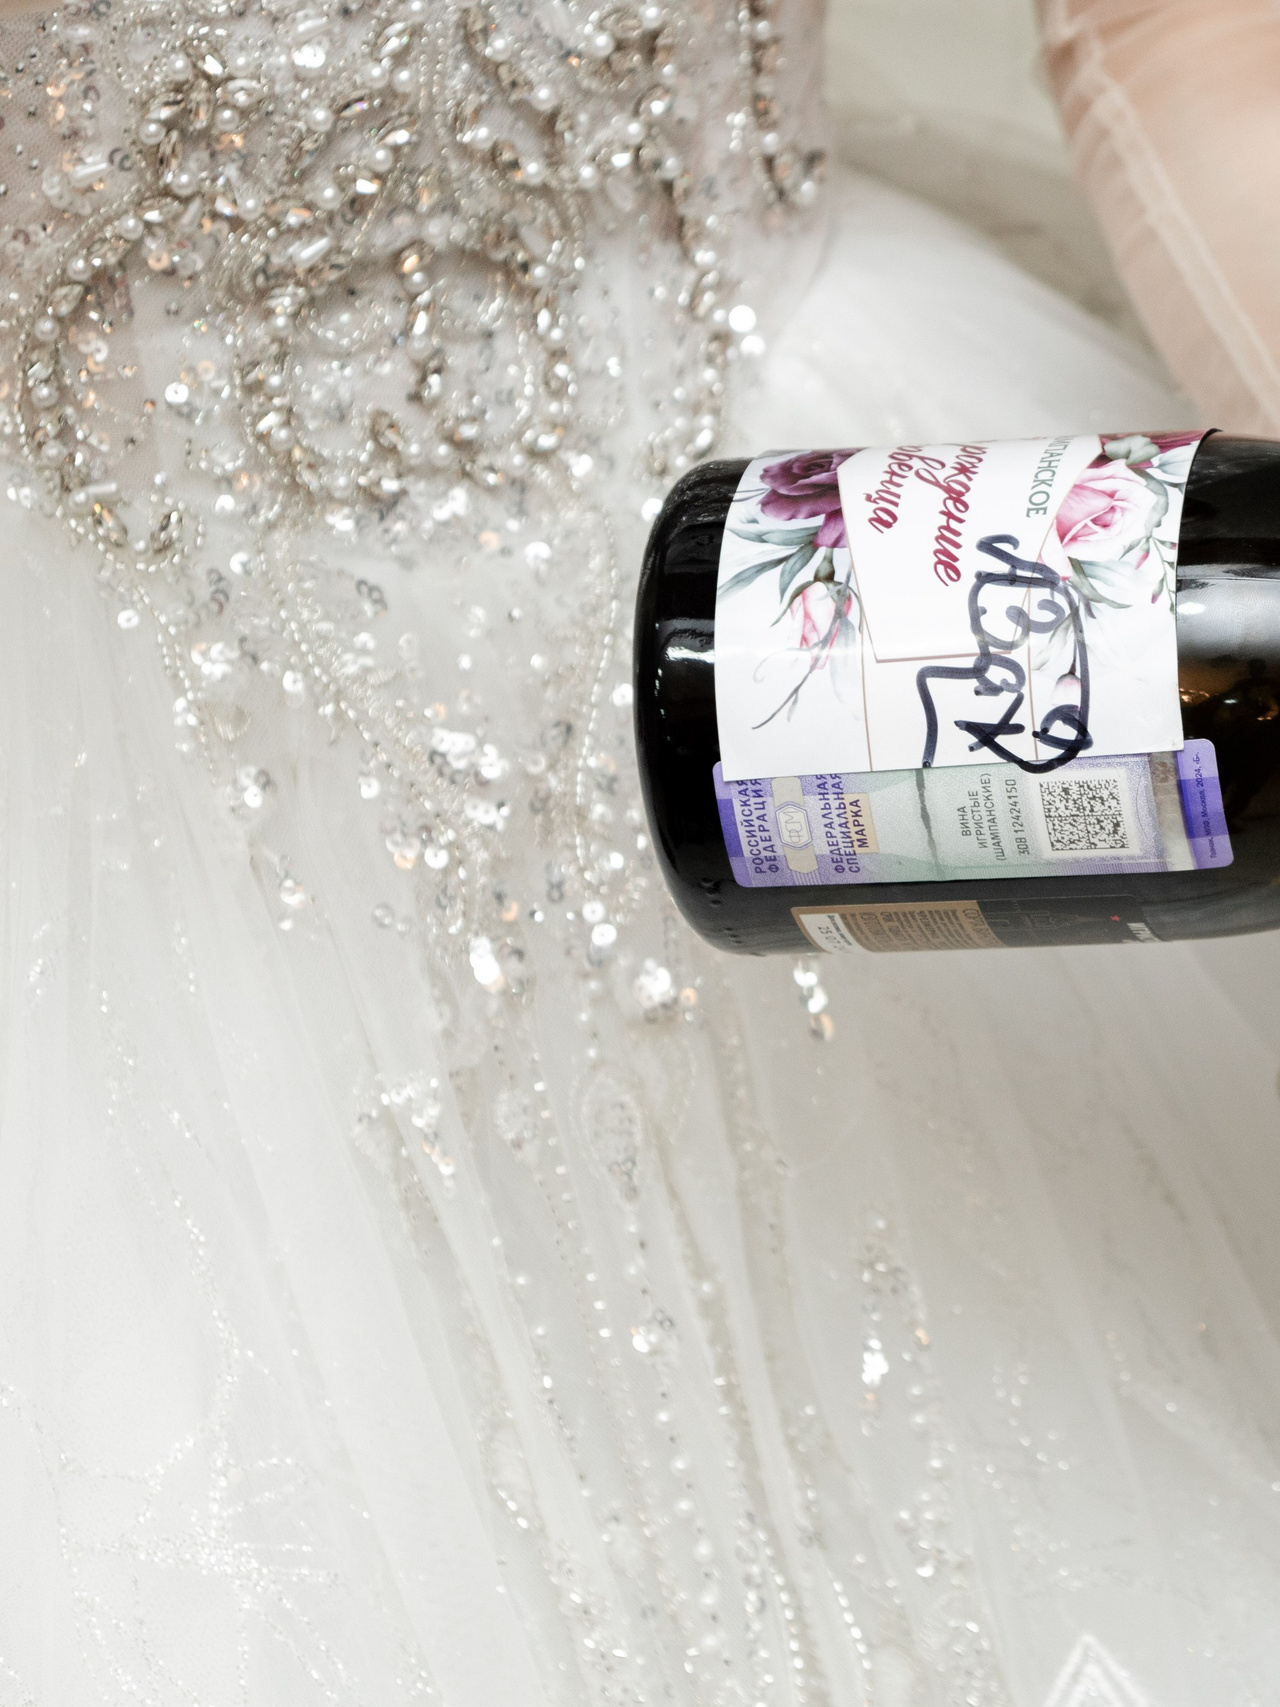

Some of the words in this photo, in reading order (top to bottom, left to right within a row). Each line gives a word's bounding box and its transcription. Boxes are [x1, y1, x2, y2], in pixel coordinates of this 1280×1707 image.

[849, 799, 869, 848] МАРКА
[957, 806, 972, 836] ВИНА
[968, 790, 988, 849] ИГРИСТЫЕ
[980, 773, 1007, 861] (ШАМПАНСКИЕ)
[1005, 779, 1024, 834] 12424150
[1015, 837, 1030, 856] 308
